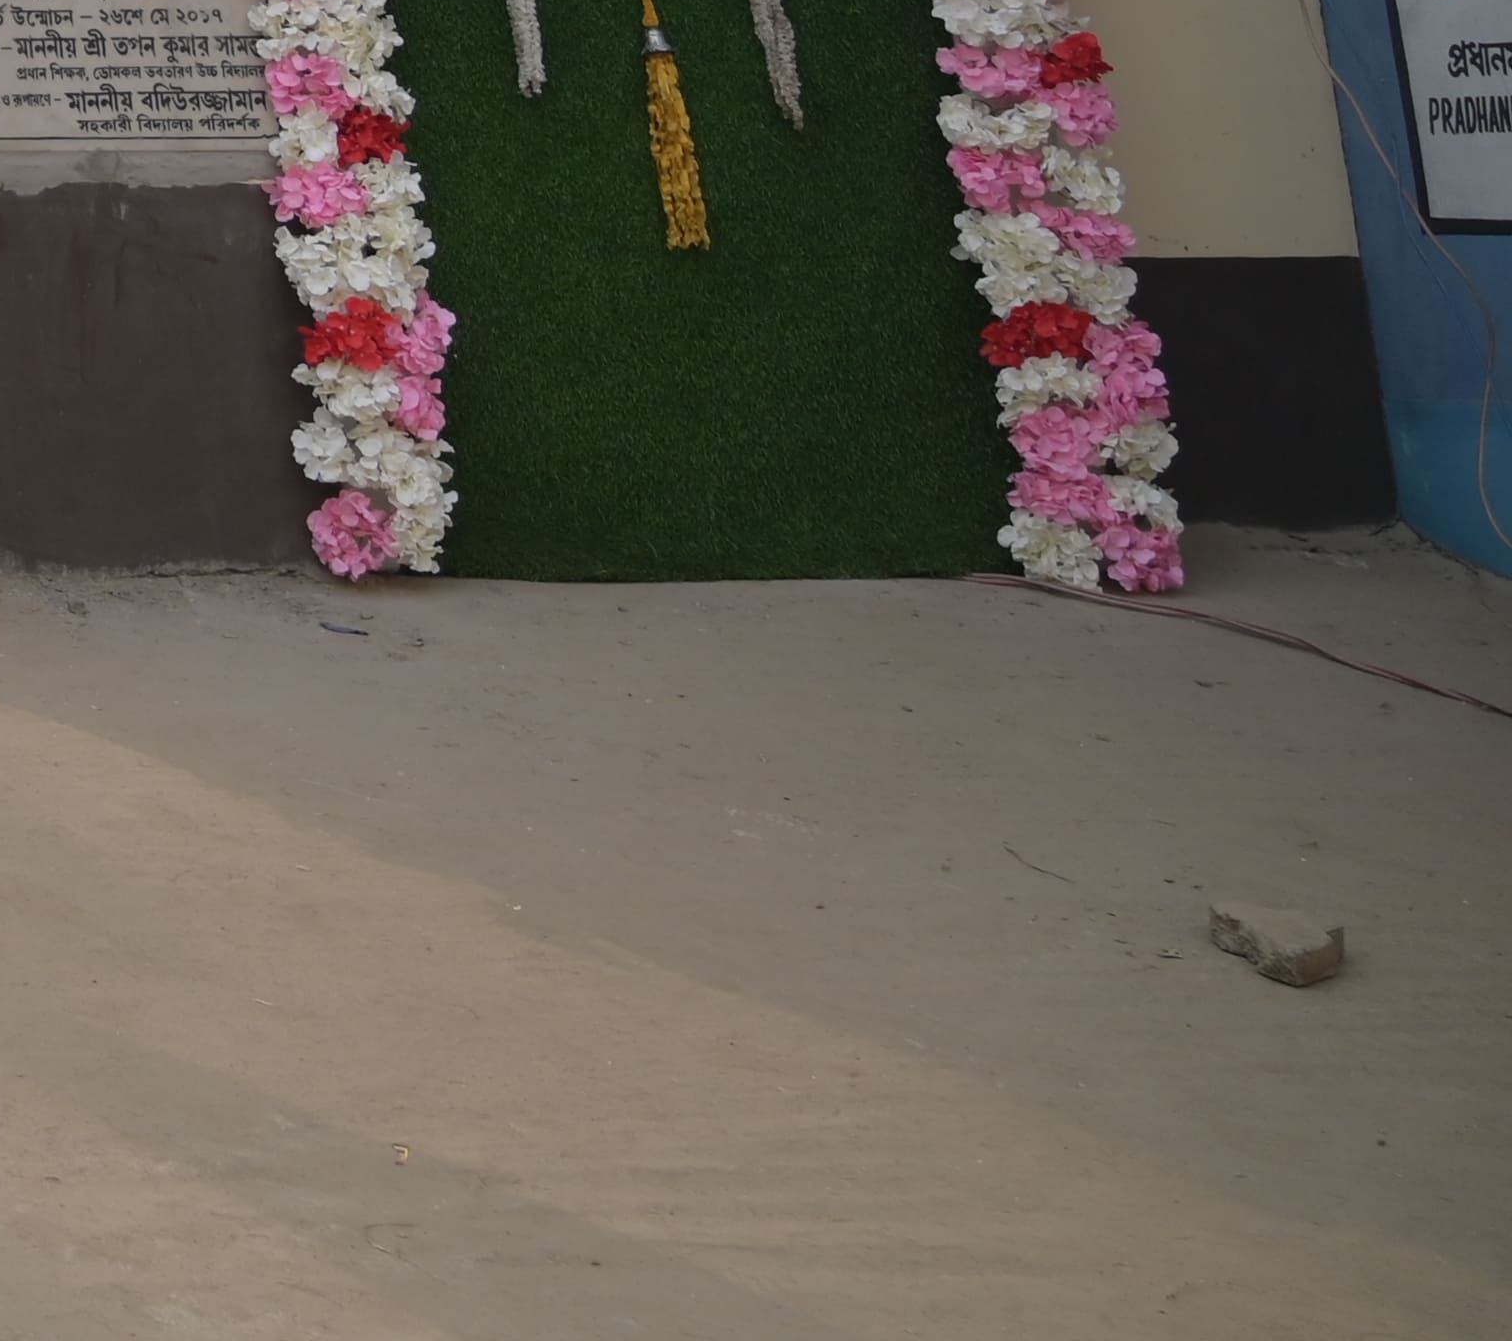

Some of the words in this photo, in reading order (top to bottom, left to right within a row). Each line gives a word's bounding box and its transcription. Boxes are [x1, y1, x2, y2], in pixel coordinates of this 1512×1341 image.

[99, 7, 143, 27] ২৬শে
[149, 8, 170, 25] মে
[176, 8, 223, 25] ২০১৭
[13, 29, 77, 59] মাননীয়
[81, 28, 106, 59] শ্রী
[160, 33, 209, 63] কুমার
[64, 83, 133, 113] মাননীয়
[76, 114, 131, 134] সহকারী
[137, 113, 193, 133] বিদ্যালয়
[199, 112, 261, 133] পরিদর্শক
[1428, 95, 1512, 135] PRADHAN
